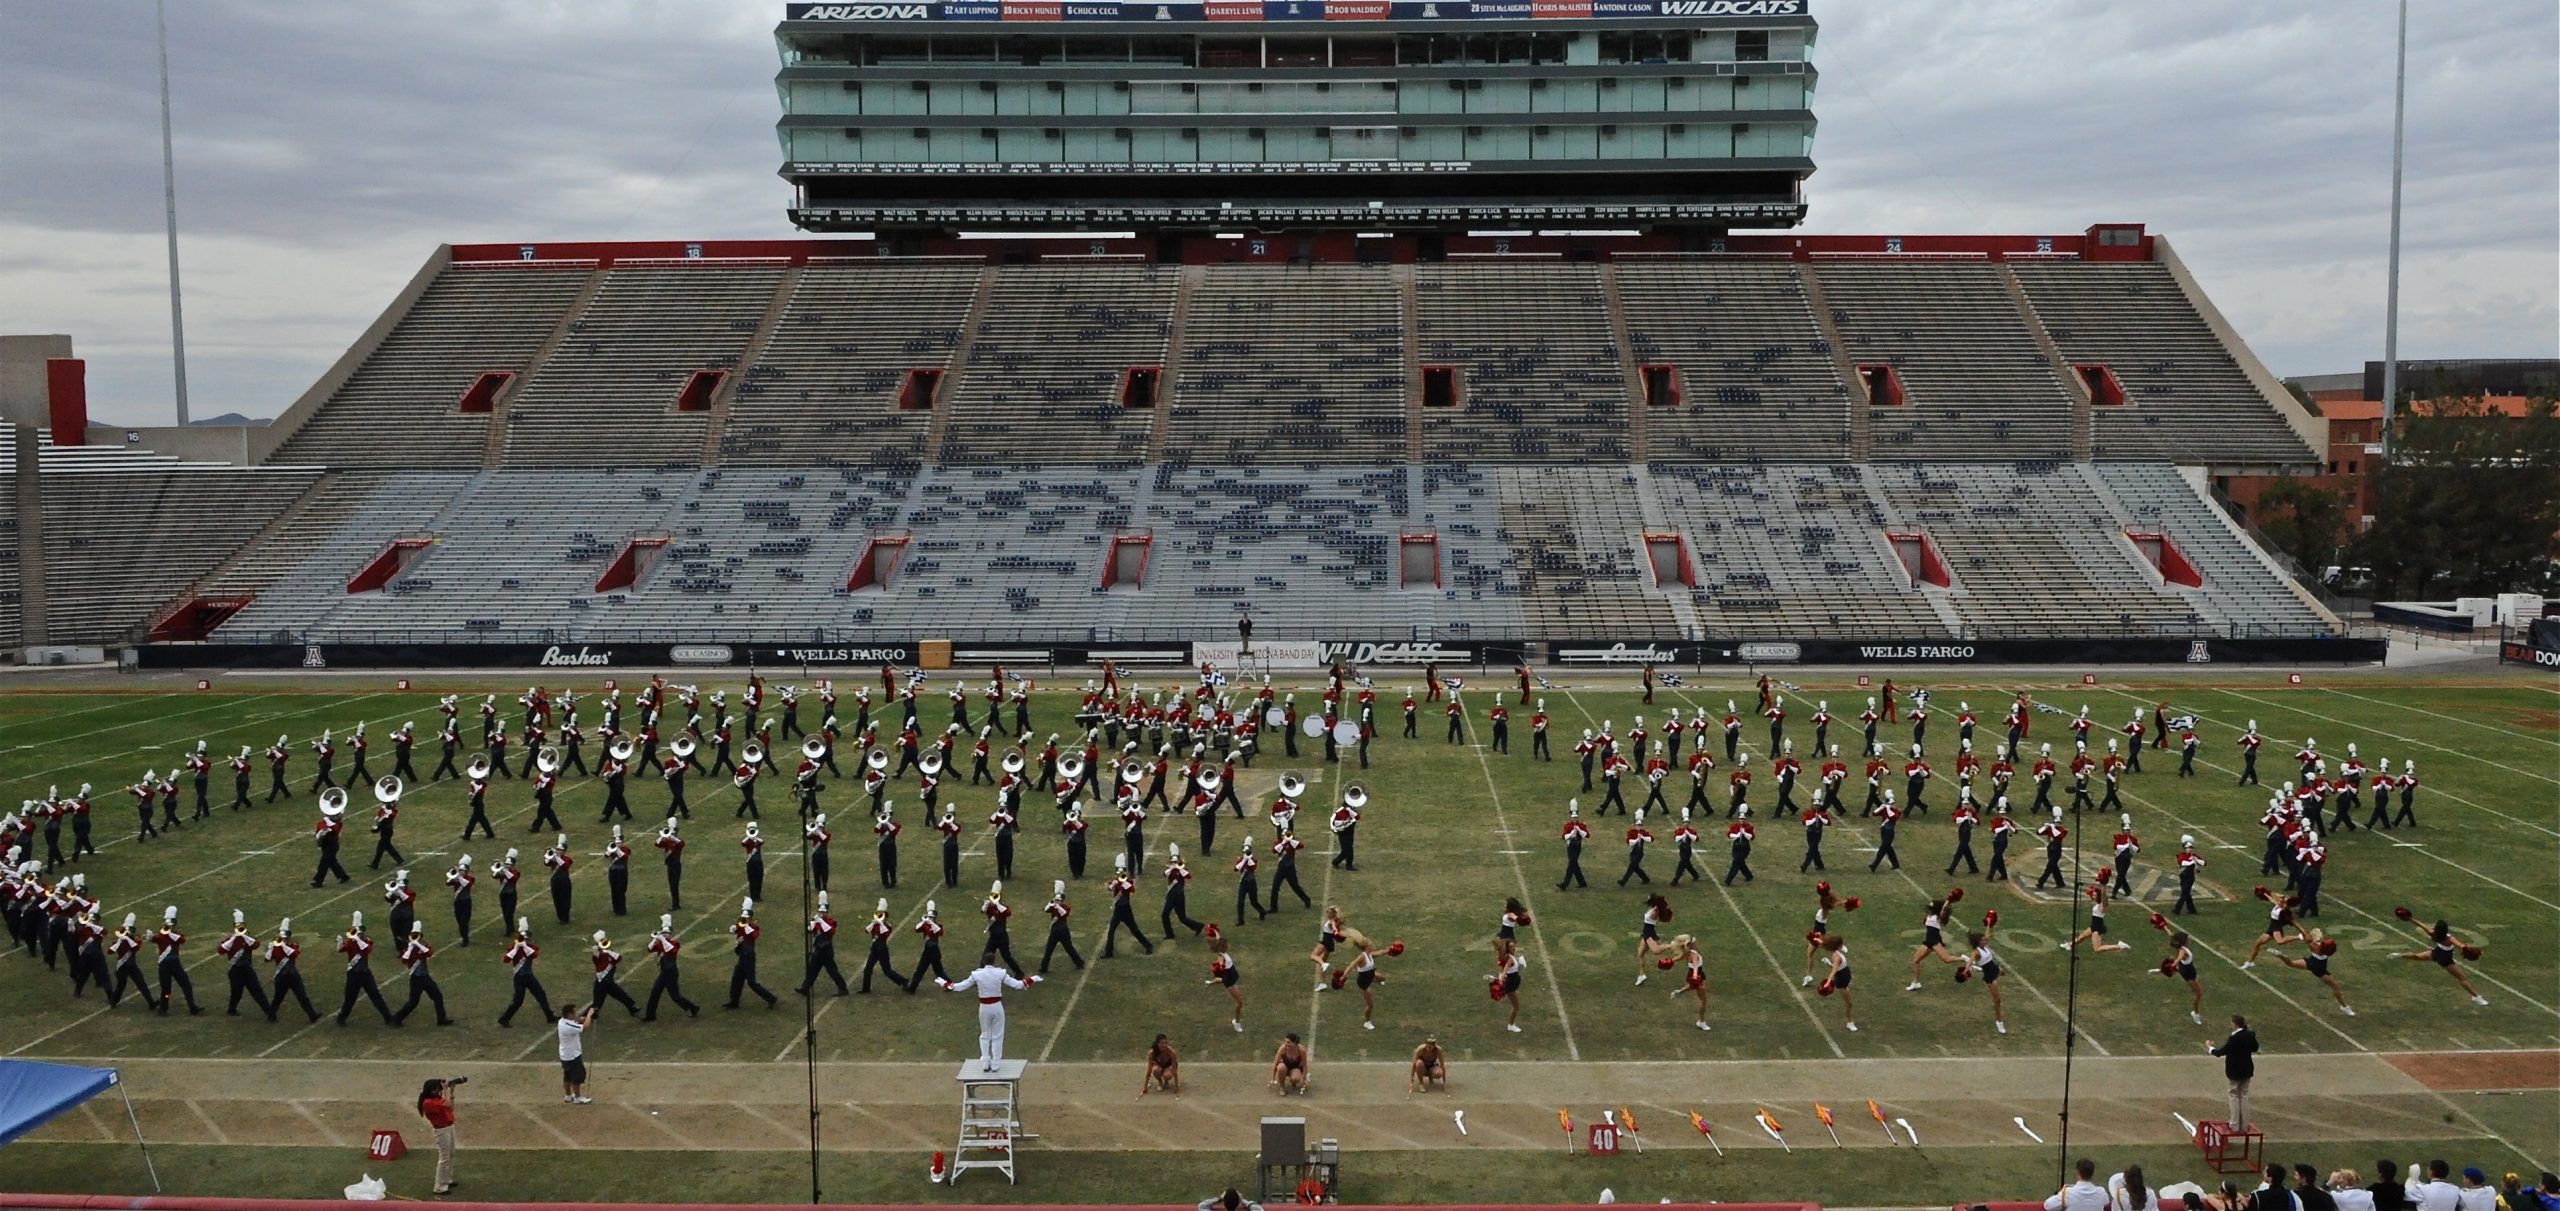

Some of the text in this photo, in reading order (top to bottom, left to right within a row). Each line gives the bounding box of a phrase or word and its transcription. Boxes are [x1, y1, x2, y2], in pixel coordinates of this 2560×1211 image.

[944, 6, 999, 15] 22 ART LUPPINO
[1034, 7, 1061, 15] HUNLEY
[1073, 7, 1098, 15] CHUCK
[1098, 7, 1119, 15] CECIL
[1210, 7, 1241, 15] DARRYLL
[1242, 7, 1263, 15] LEWIS
[1334, 6, 1349, 14] BOB
[1350, 6, 1384, 14] WALDROP
[1558, 3, 1592, 11] McALISTER
[1598, 3, 1627, 11] ANTOINE
[1628, 3, 1652, 11] CASON
[1661, 1, 1800, 15] WILDCATS
[801, 5, 928, 19] ARIZONA
[878, 247, 889, 257] 19
[1091, 246, 1104, 255] 20
[1253, 244, 1264, 254] 21
[1496, 244, 1509, 253] 22
[1712, 243, 1725, 252] 23
[1887, 243, 1901, 252] 24
[2038, 243, 2051, 252] 25
[522, 251, 533, 261] 17
[688, 249, 700, 258] 18
[128, 432, 139, 441] 16
[791, 649, 905, 660] WELLS FARGO
[1196, 649, 1234, 659] UNIVERSITY
[1279, 649, 1299, 659] BAND
[1300, 649, 1315, 659] DAY
[1760, 646, 1795, 655] CASINOS
[1861, 646, 1975, 657] WELLS FARGO
[540, 646, 612, 665] Bashas'
[1593, 1129, 1613, 1150] 40
[371, 1134, 392, 1156] 40
